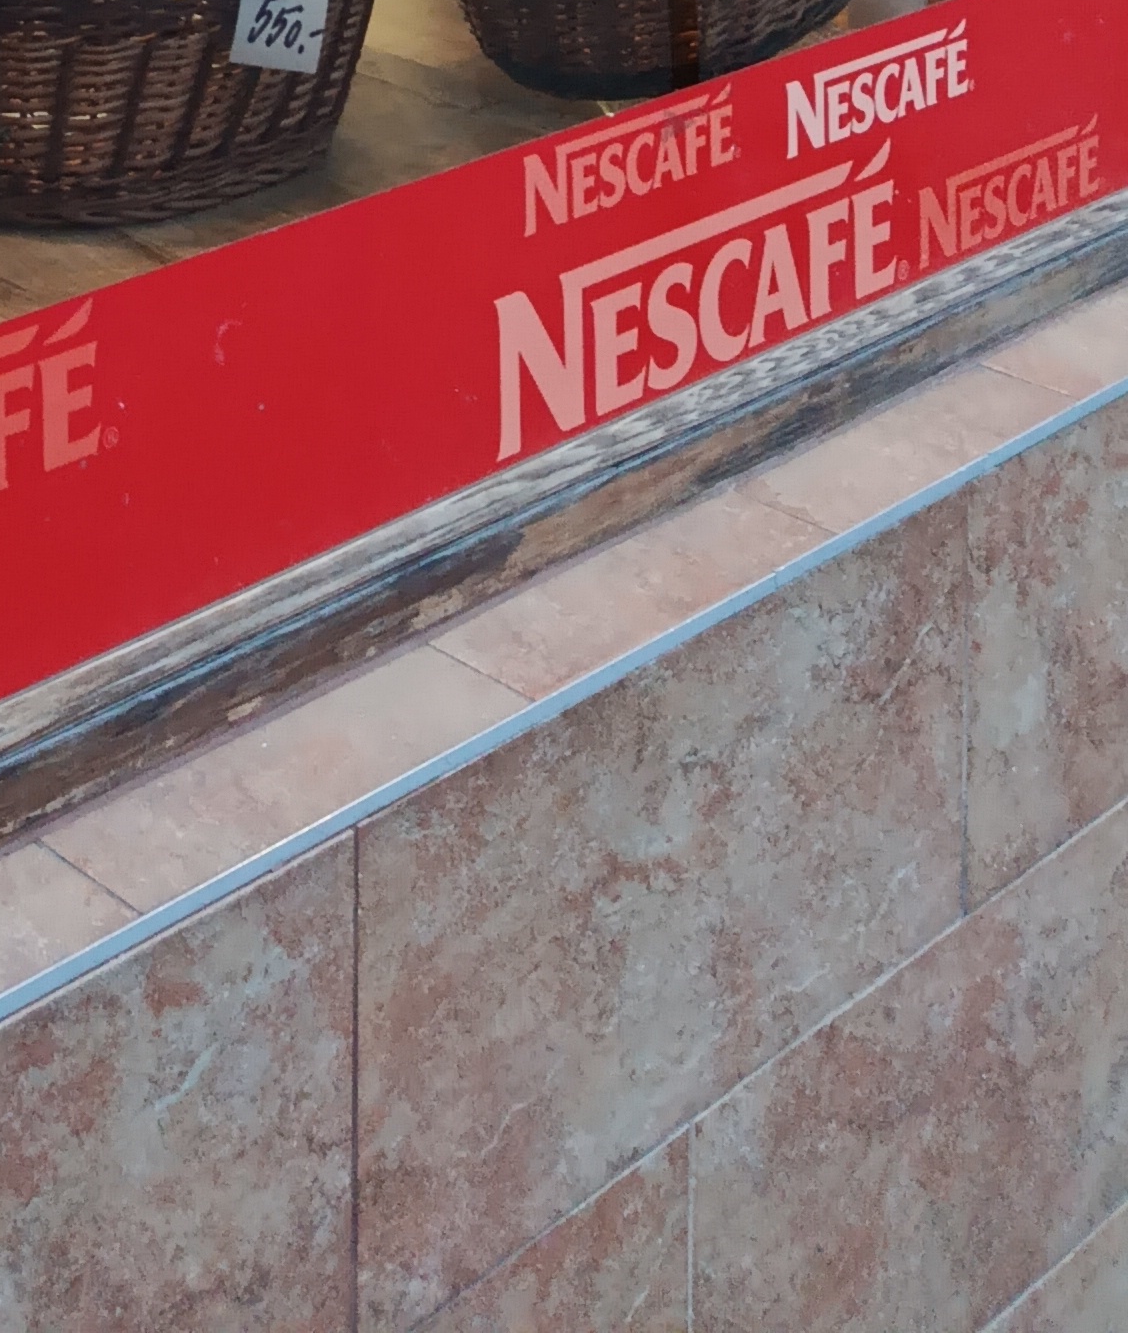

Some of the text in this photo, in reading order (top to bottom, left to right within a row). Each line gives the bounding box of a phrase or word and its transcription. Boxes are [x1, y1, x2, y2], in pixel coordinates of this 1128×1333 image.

[522, 83, 736, 238] NESCAFÉ
[785, 18, 969, 160] NESCAFÉ
[919, 114, 1101, 269] NESCAFÉ
[494, 138, 898, 463] NESCAFÉ
